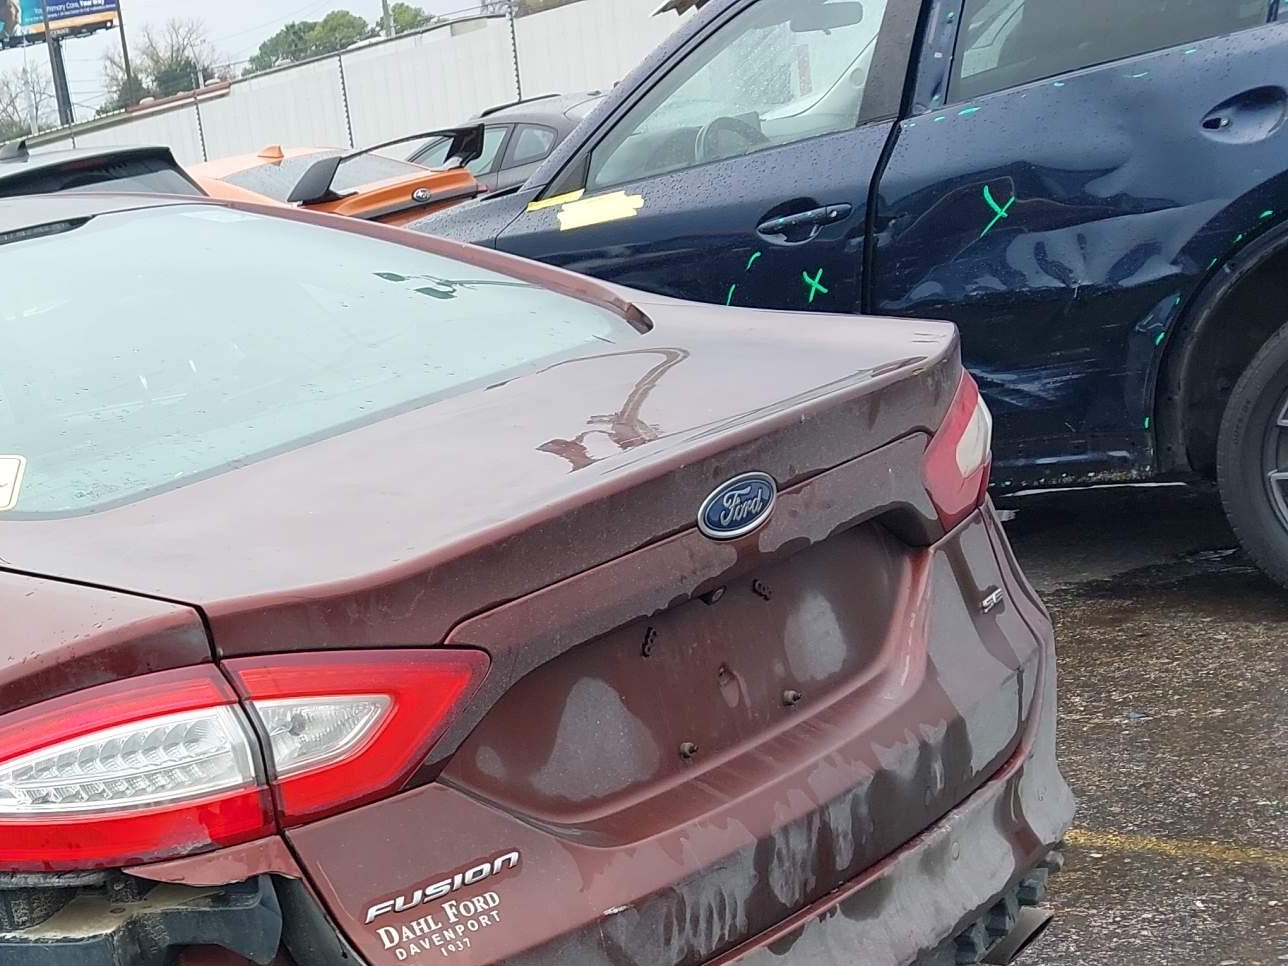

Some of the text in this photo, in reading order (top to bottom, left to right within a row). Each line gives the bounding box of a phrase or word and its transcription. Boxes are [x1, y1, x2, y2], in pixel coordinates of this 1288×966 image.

[720, 486, 763, 526] Ford
[982, 588, 1003, 613] SE
[364, 851, 520, 925] FUSION
[395, 910, 501, 961] DAVENPORT
[440, 938, 472, 957] 1937
